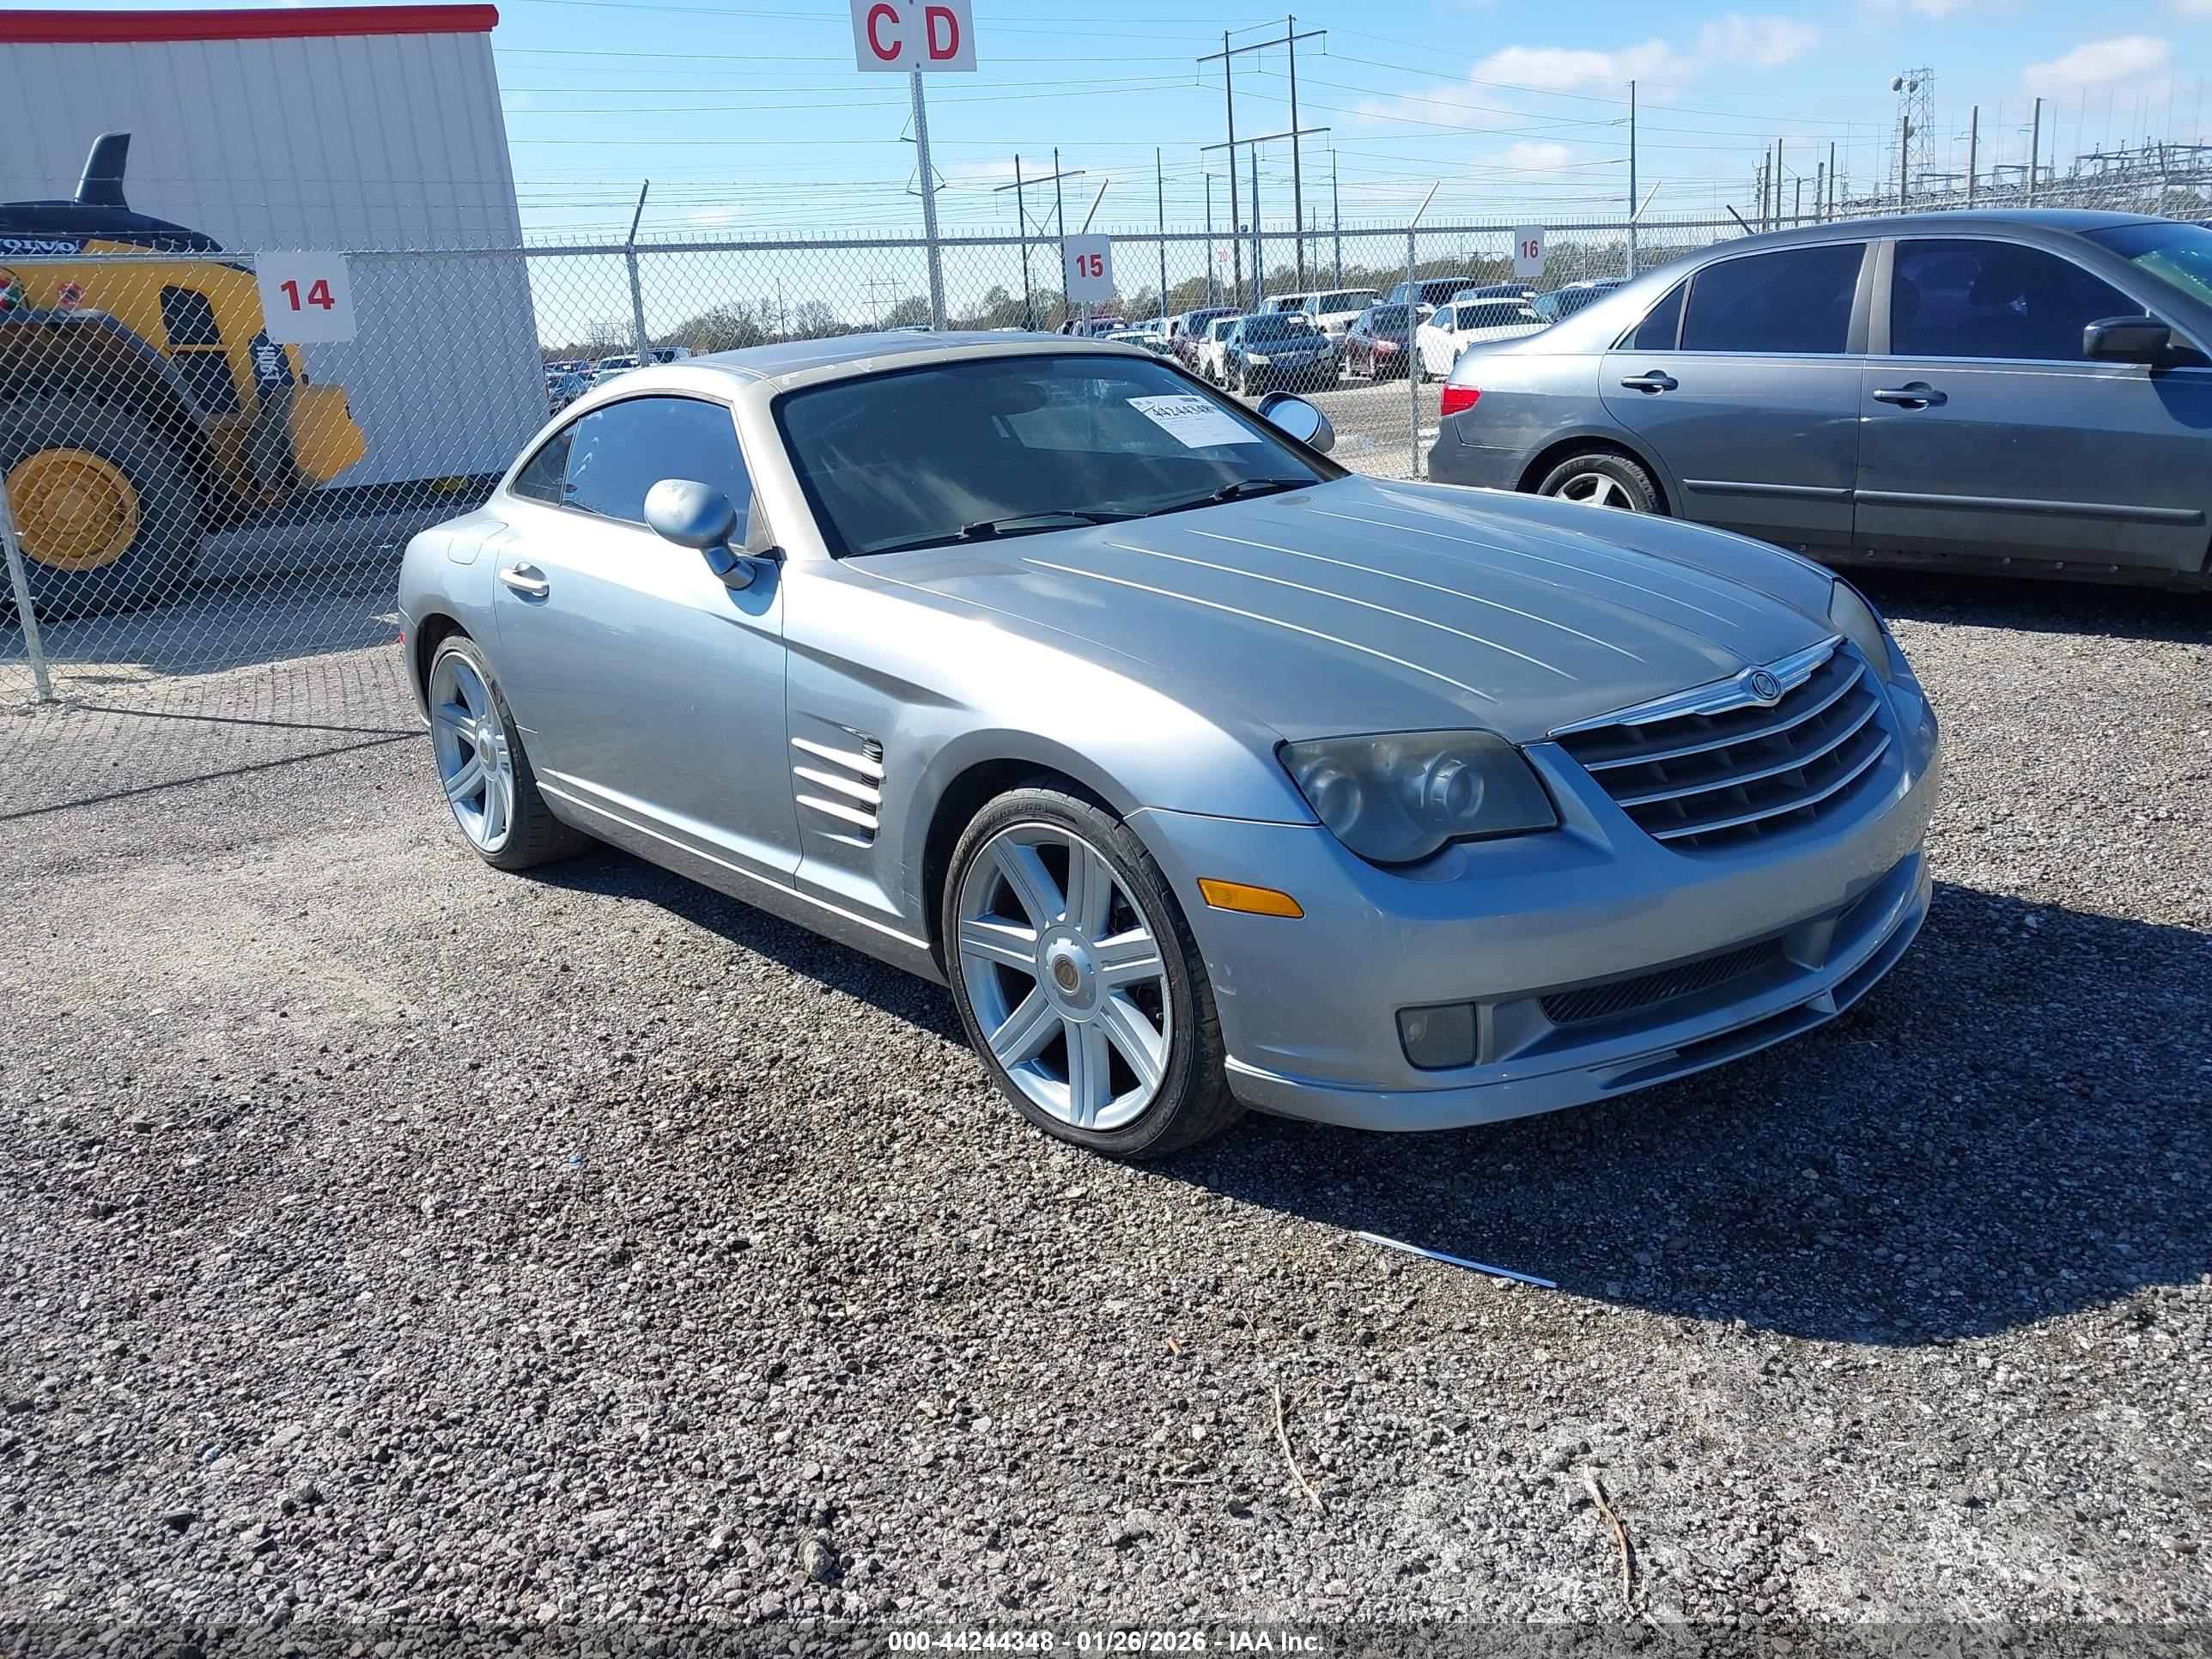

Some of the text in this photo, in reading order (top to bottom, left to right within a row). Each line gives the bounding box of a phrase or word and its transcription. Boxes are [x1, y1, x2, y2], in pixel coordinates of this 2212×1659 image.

[867, 3, 959, 61] C D
[0, 239, 76, 252] OLVO
[1521, 240, 1539, 258] 16
[1076, 253, 1103, 277] 15
[280, 279, 335, 311] 14
